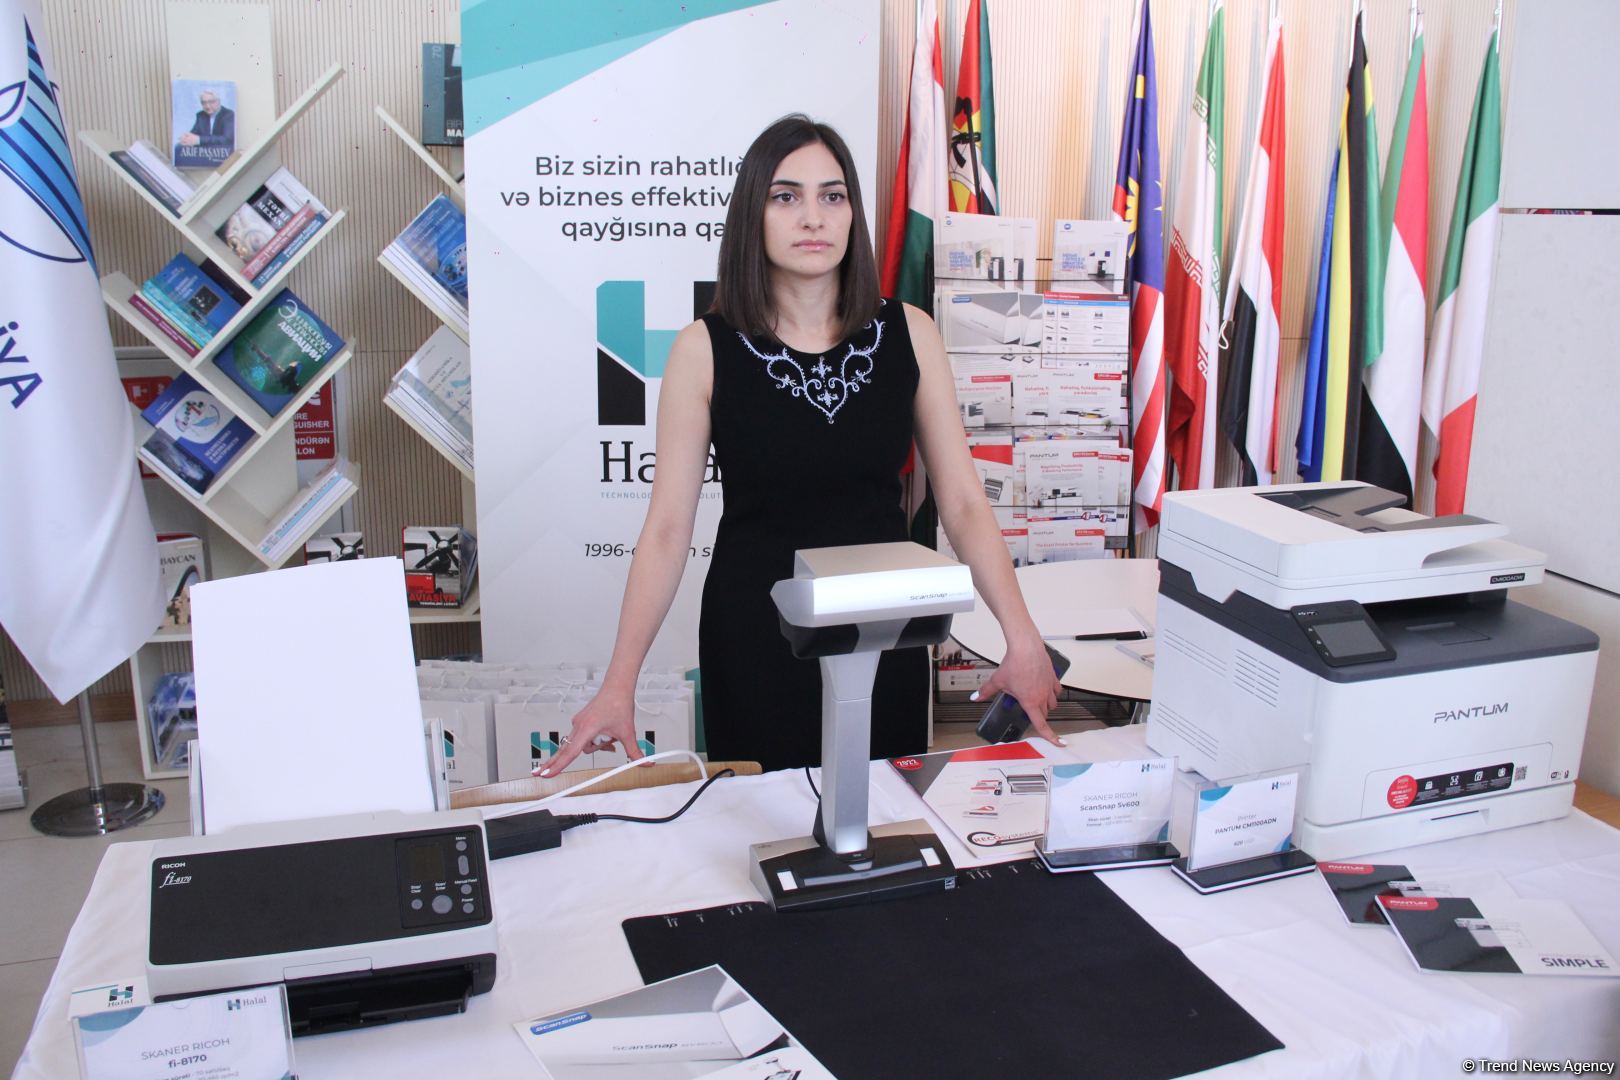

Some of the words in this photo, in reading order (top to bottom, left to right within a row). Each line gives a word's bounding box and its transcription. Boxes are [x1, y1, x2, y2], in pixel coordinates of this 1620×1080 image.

[535, 156, 575, 176] Biz
[582, 155, 641, 176] sizin
[500, 190, 530, 207] və
[539, 186, 623, 207] biznes
[561, 216, 687, 242] qayğısına
[296, 447, 315, 455] LON
[1433, 702, 1509, 724] PANTUM
[1079, 802, 1116, 812] ScanSnap
[1214, 824, 1242, 835] PANTUM
[161, 862, 186, 870] RICOH
[1541, 957, 1609, 969] SIMPLE
[107, 998, 133, 1007] Halal
[242, 995, 268, 1007] Halal
[535, 1013, 588, 1033] ScanSnap
[140, 1044, 190, 1061] SKANER
[192, 1037, 230, 1050] RICOH
[612, 1041, 678, 1051] ScanSnap
[167, 1053, 208, 1069] fi-8170
